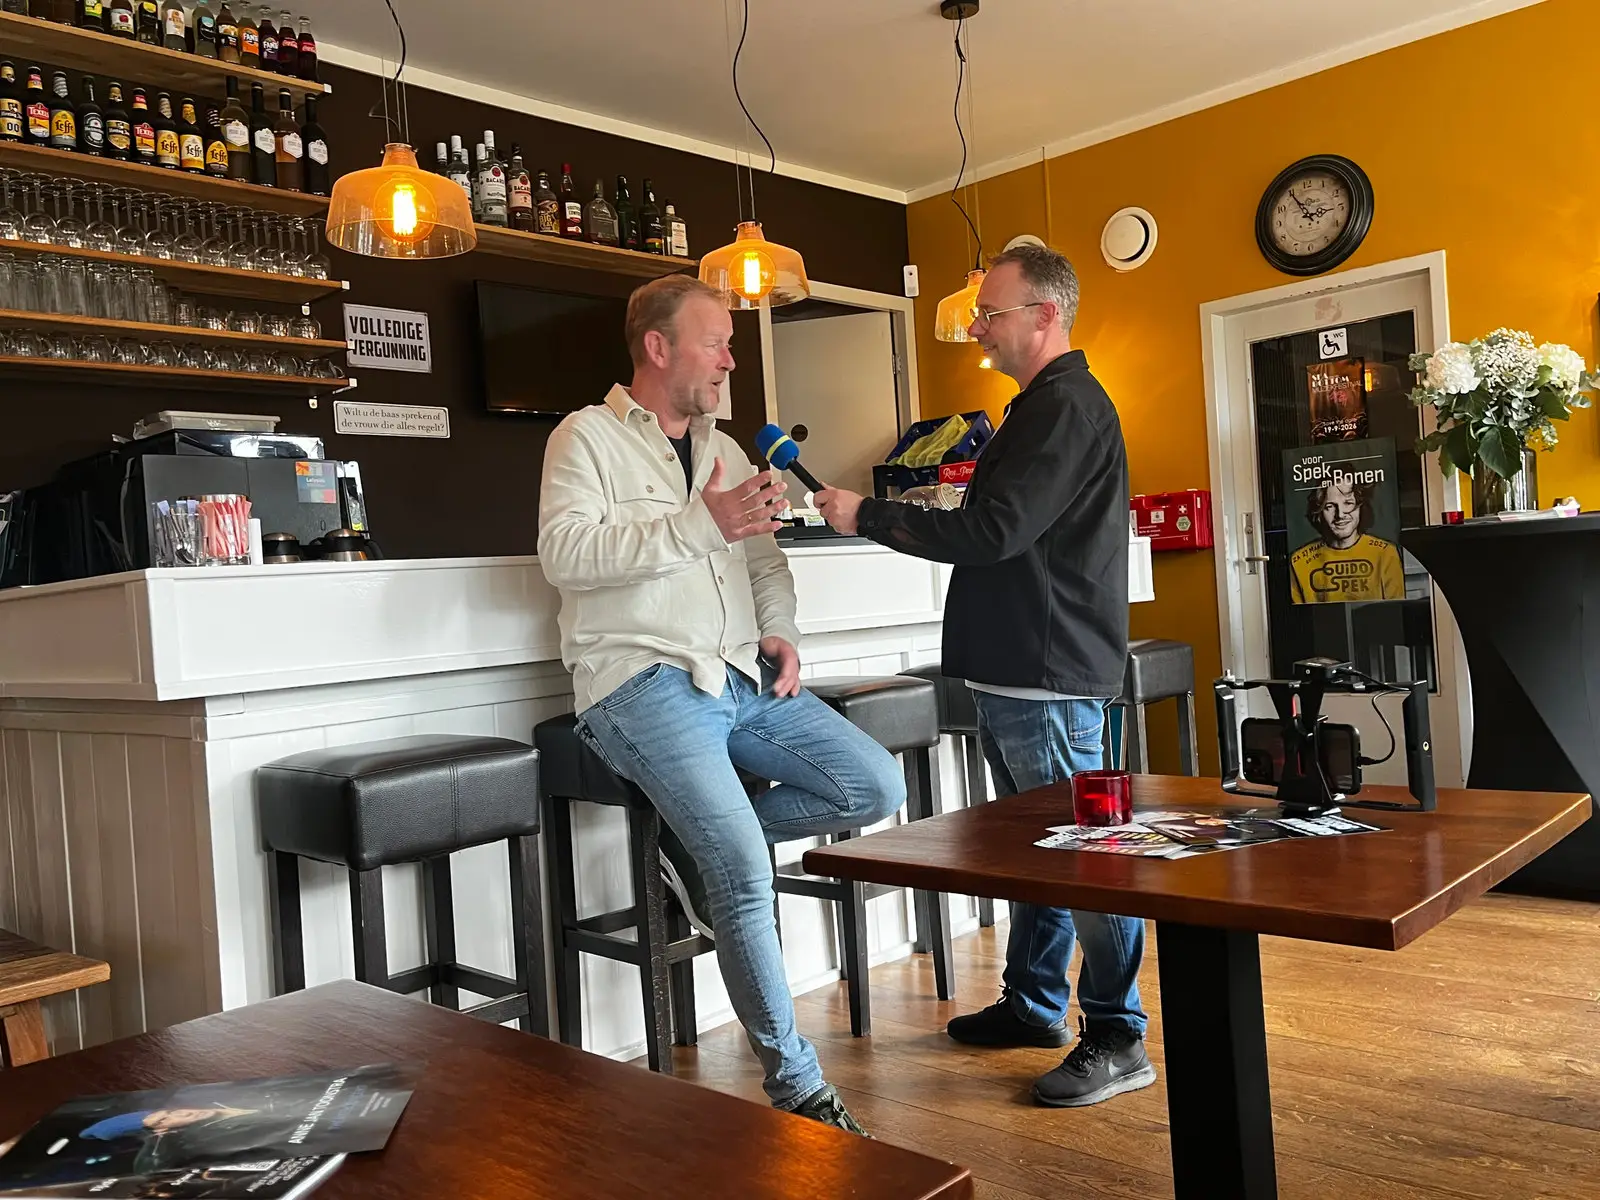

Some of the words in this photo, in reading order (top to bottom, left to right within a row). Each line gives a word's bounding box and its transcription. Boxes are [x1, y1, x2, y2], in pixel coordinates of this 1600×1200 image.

[55, 120, 73, 133] Leffe
[186, 144, 203, 157] Leffe
[1277, 205, 1286, 214] 10
[349, 315, 424, 340] VOLLEDIGE
[343, 407, 361, 417] Wilt
[369, 408, 380, 417] de
[381, 409, 399, 419] baas
[401, 411, 432, 421] spreken
[433, 412, 441, 420] of
[341, 419, 352, 427] de
[354, 421, 379, 429] vrouw
[380, 420, 394, 430] die
[396, 421, 416, 431] alles
[418, 423, 445, 433] regelt?
[1324, 422, 1357, 433] 19-9-2026
[1302, 455, 1323, 465] voor
[1293, 462, 1332, 483] Spek
[1333, 468, 1385, 487] Bonen
[1321, 480, 1332, 488] en
[1368, 540, 1388, 550] 2027
[1331, 576, 1369, 593] SPEK
